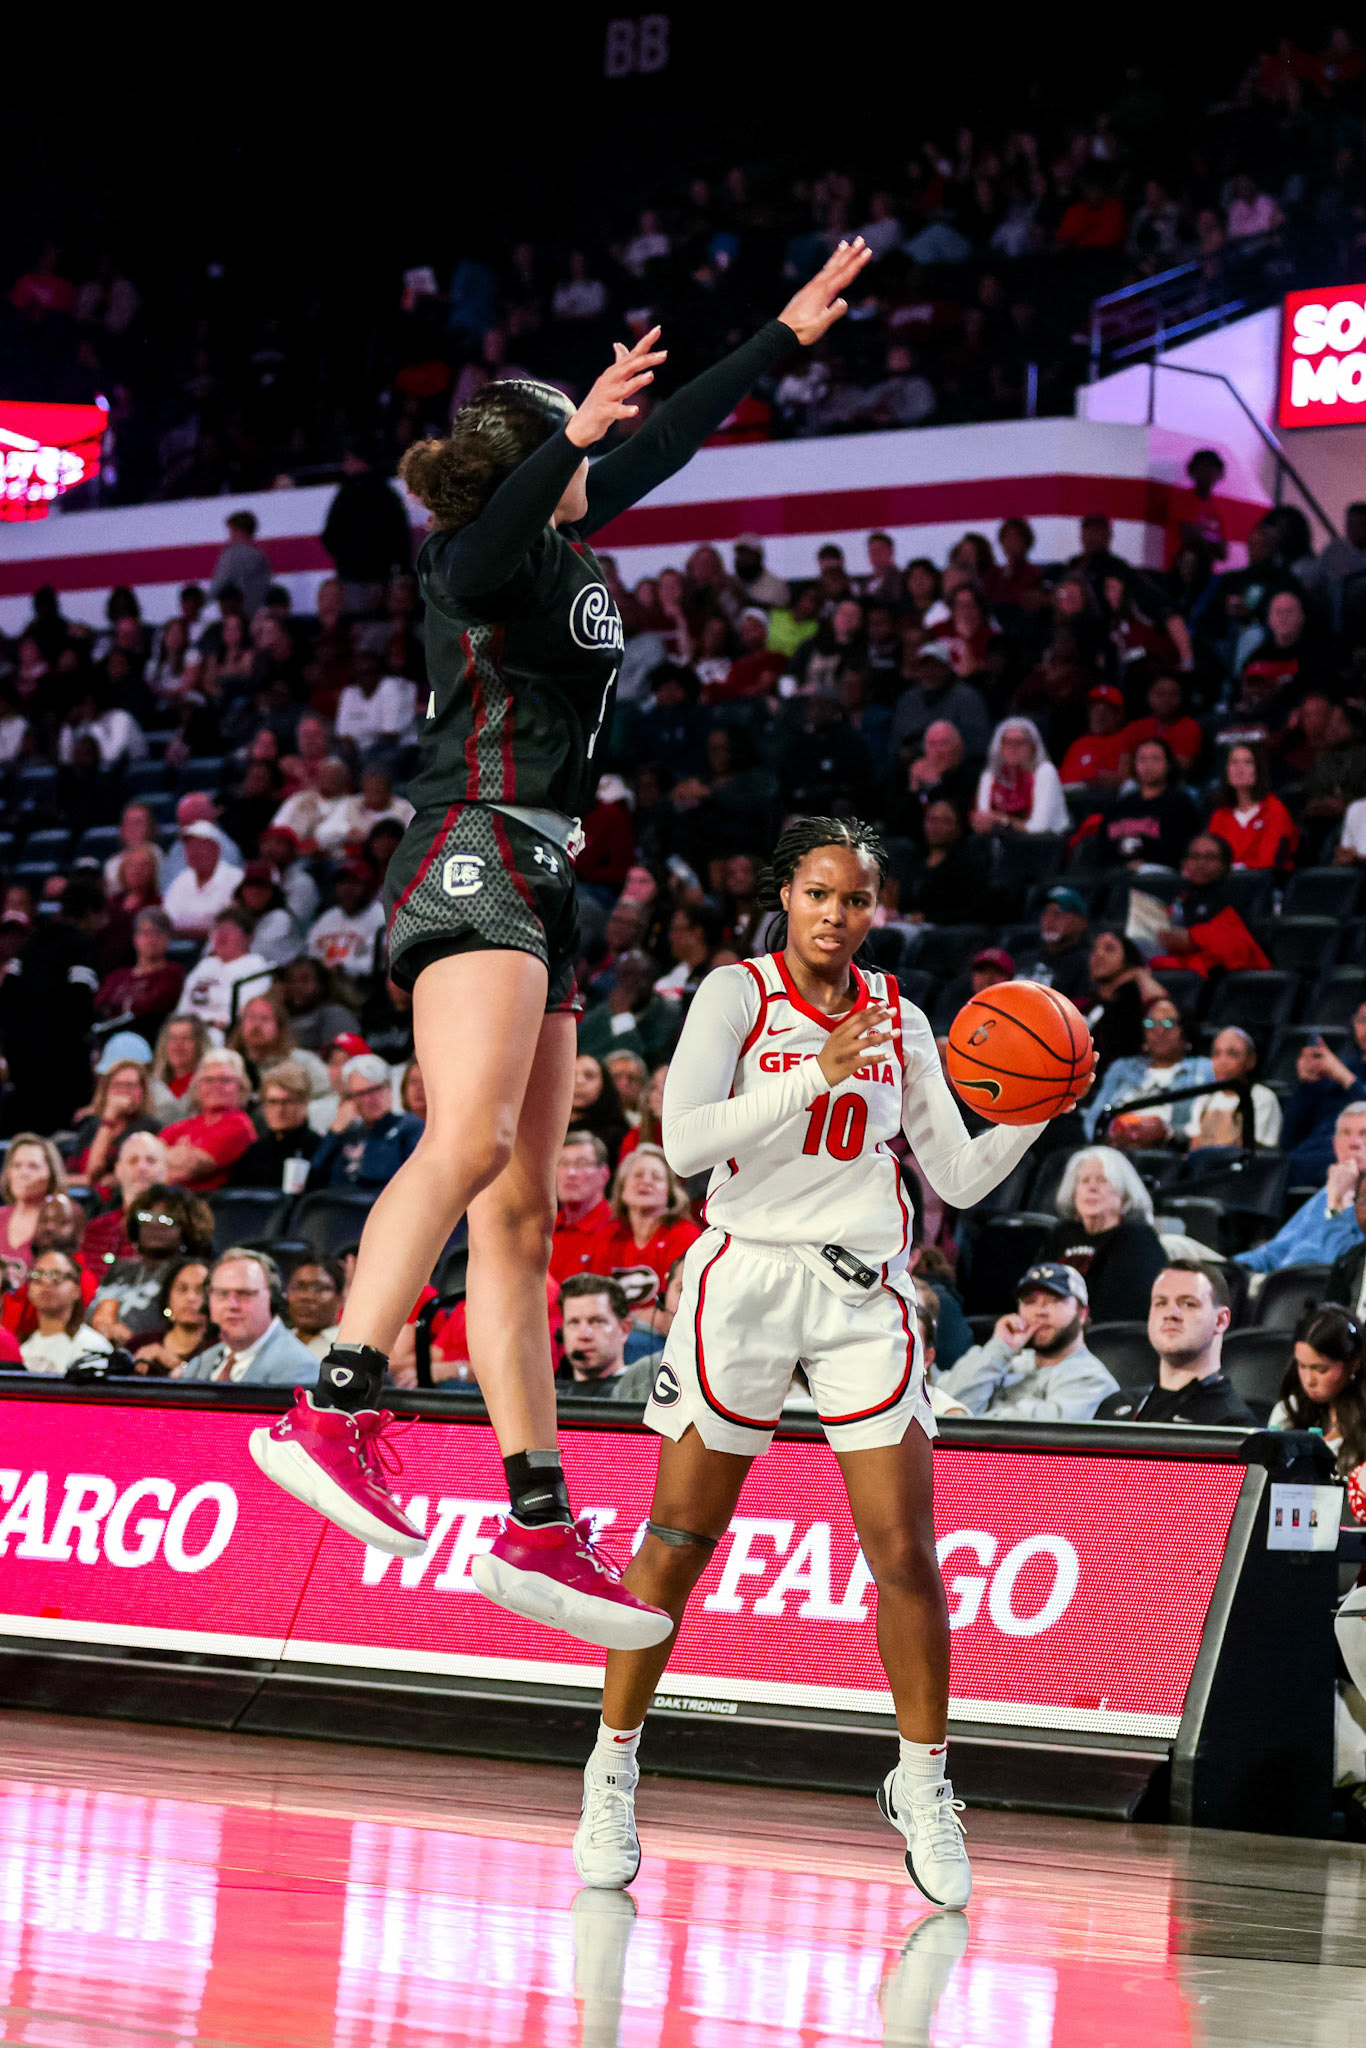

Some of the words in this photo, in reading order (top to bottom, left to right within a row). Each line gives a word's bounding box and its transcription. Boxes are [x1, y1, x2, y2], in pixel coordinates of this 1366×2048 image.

[1292, 301, 1366, 355] SO
[759, 1051, 895, 1087] GEGIA
[802, 1091, 868, 1161] 10
[652, 1363, 681, 1406] G
[0, 1467, 239, 1572] ARGO
[654, 1695, 739, 1715] DAKTRONICS
